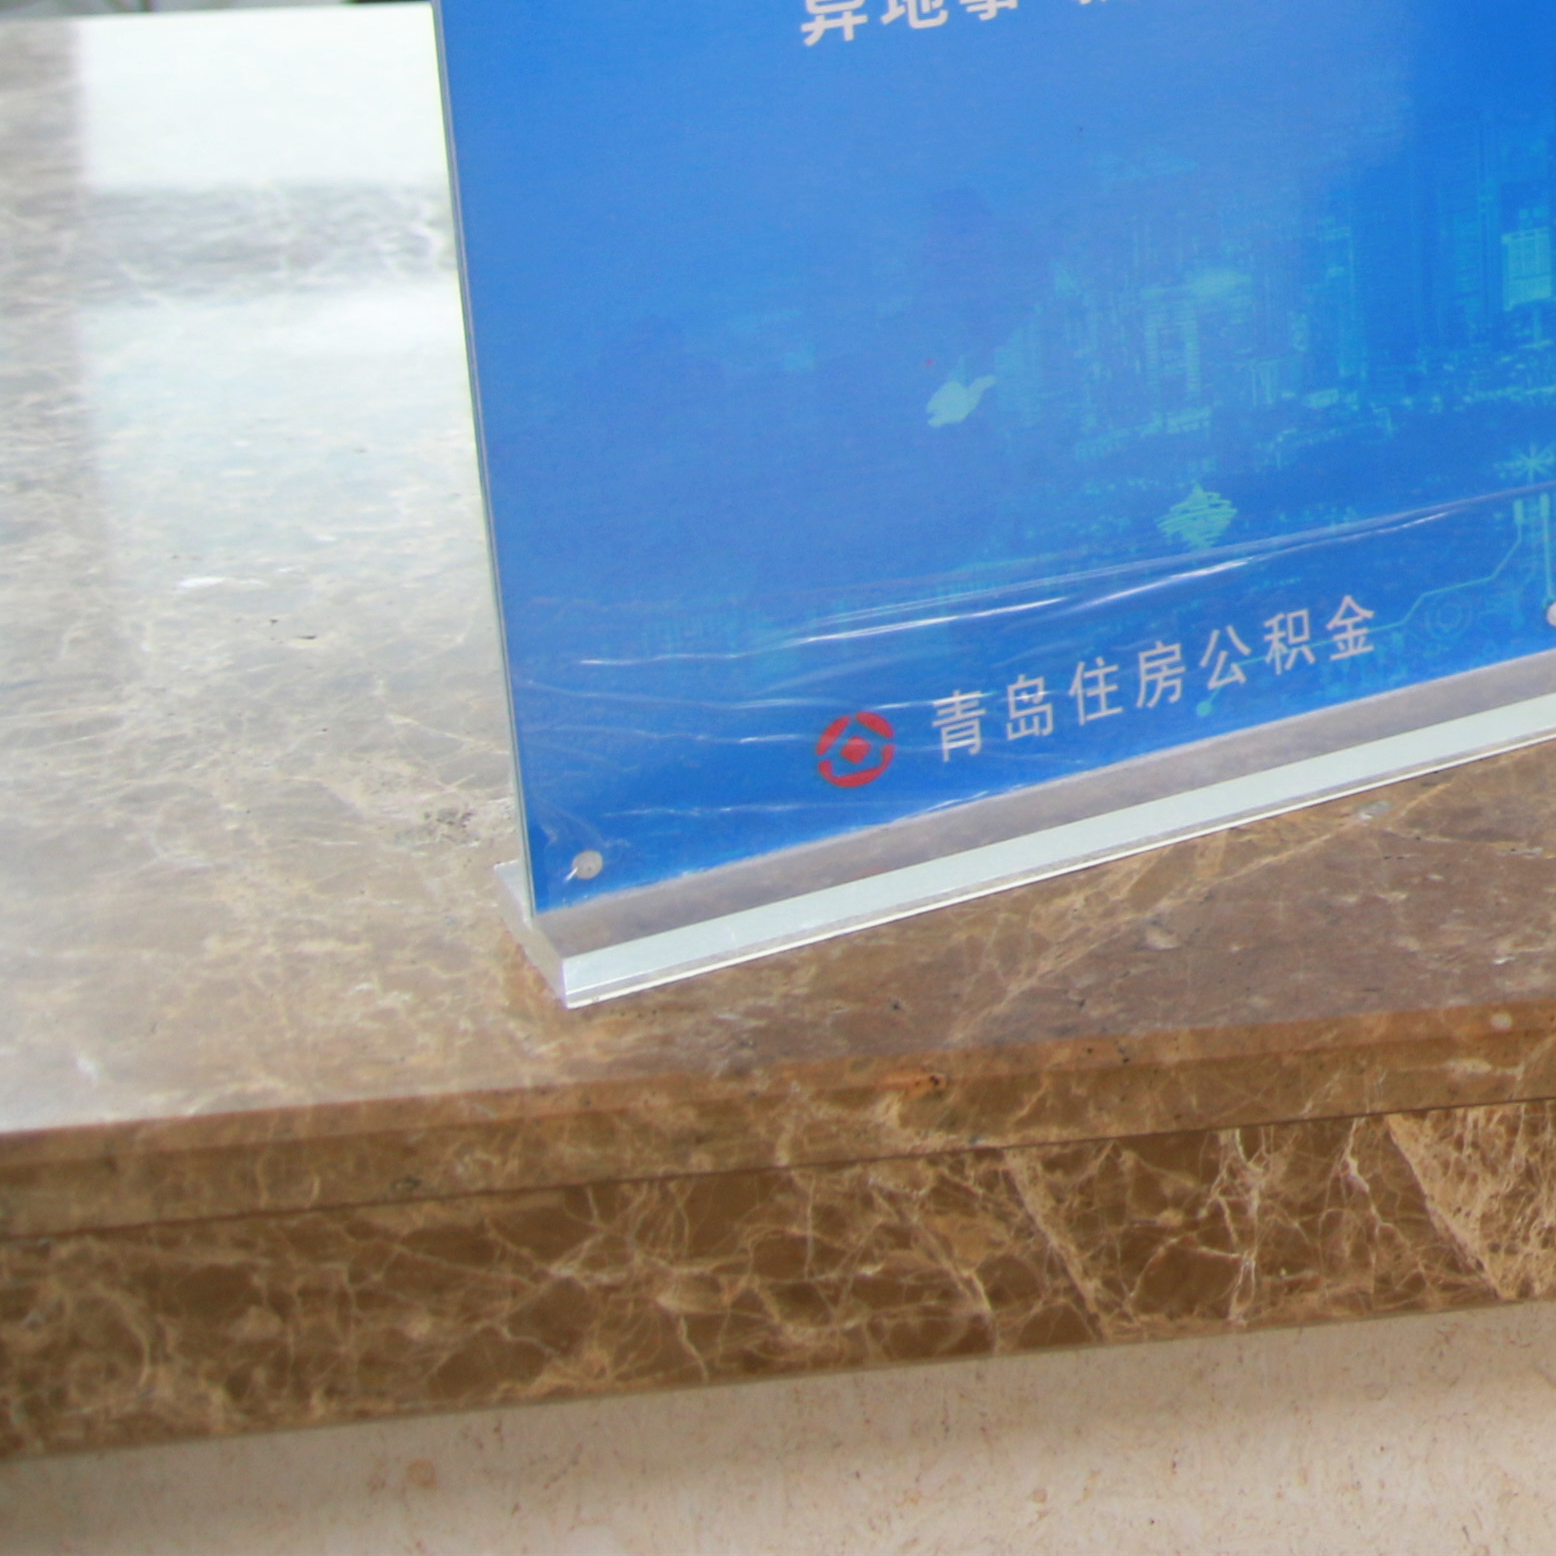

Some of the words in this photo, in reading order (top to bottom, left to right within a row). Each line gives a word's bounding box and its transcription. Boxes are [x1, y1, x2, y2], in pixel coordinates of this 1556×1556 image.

[932, 593, 1377, 764] 青岛住房公积金
